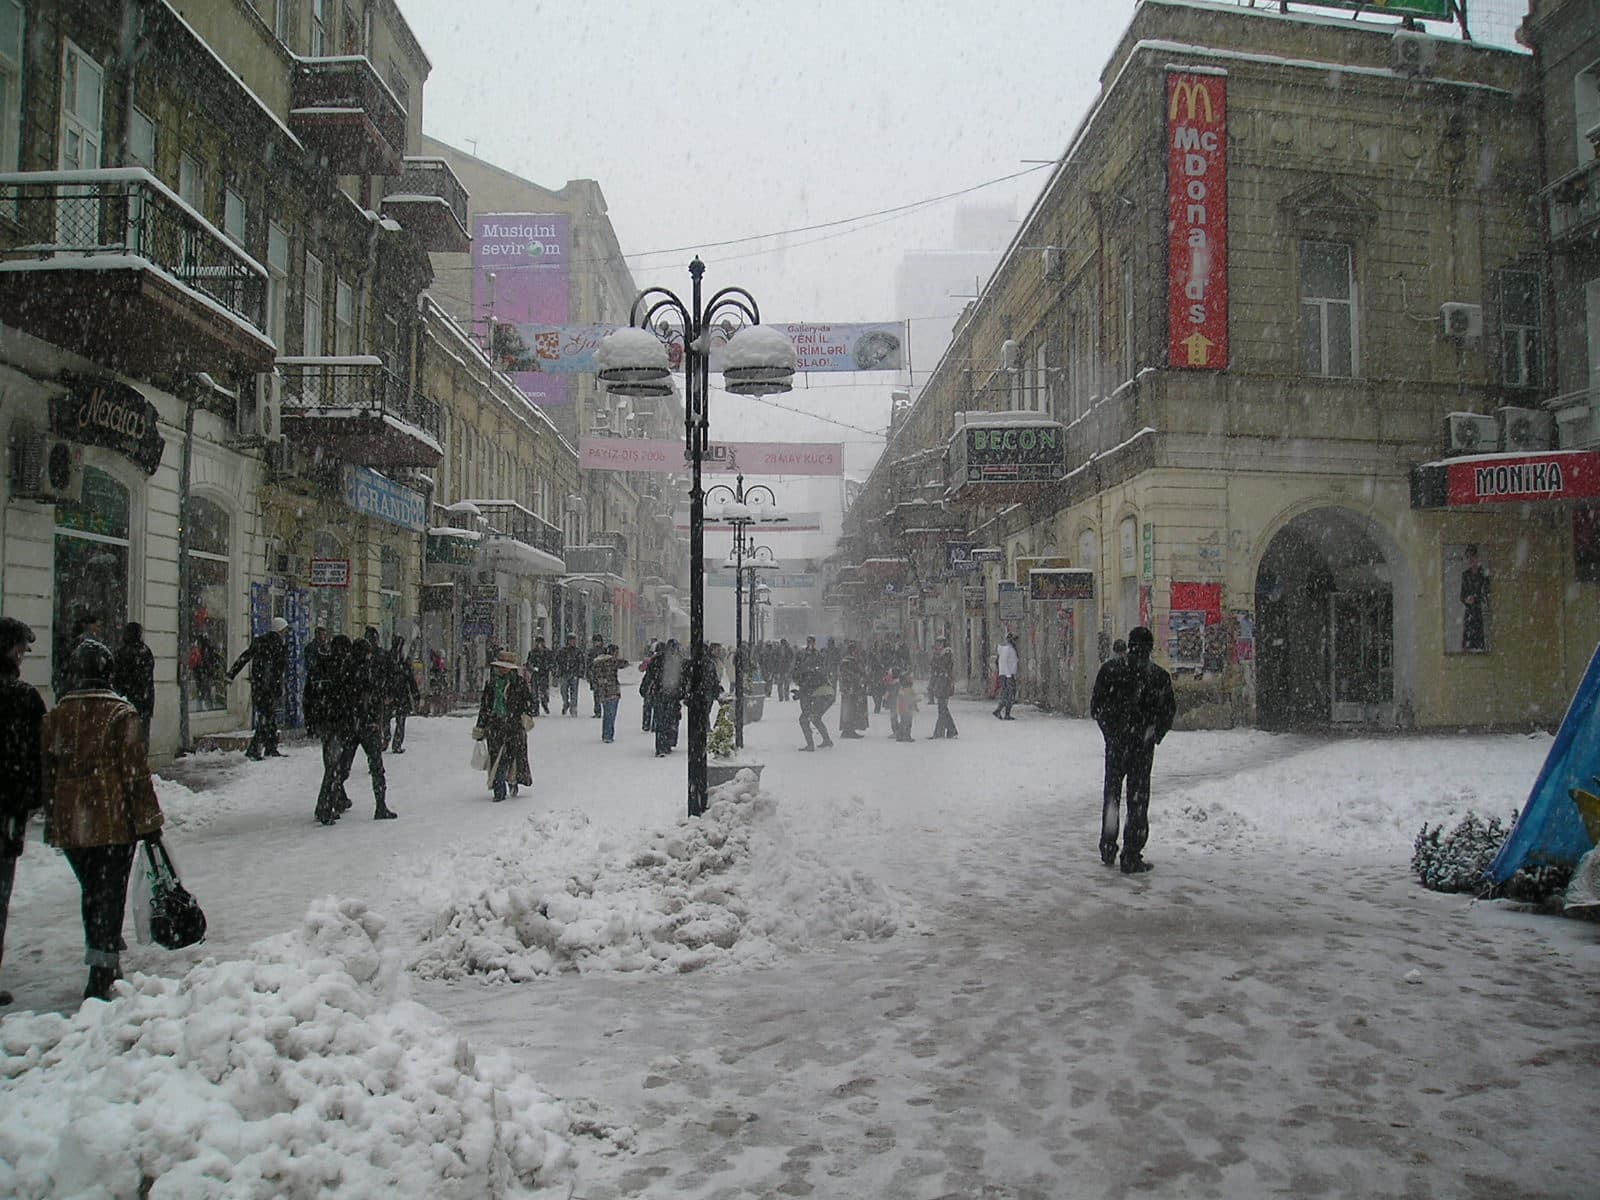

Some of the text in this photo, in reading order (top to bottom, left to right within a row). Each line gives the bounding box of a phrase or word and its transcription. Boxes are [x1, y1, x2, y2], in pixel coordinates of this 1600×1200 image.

[482, 224, 556, 239] Musiqini
[796, 345, 846, 355] İRİMLƏRİ
[974, 429, 1056, 450] BECON
[1474, 462, 1563, 496] MONIKA
[357, 484, 410, 523] GRAND
